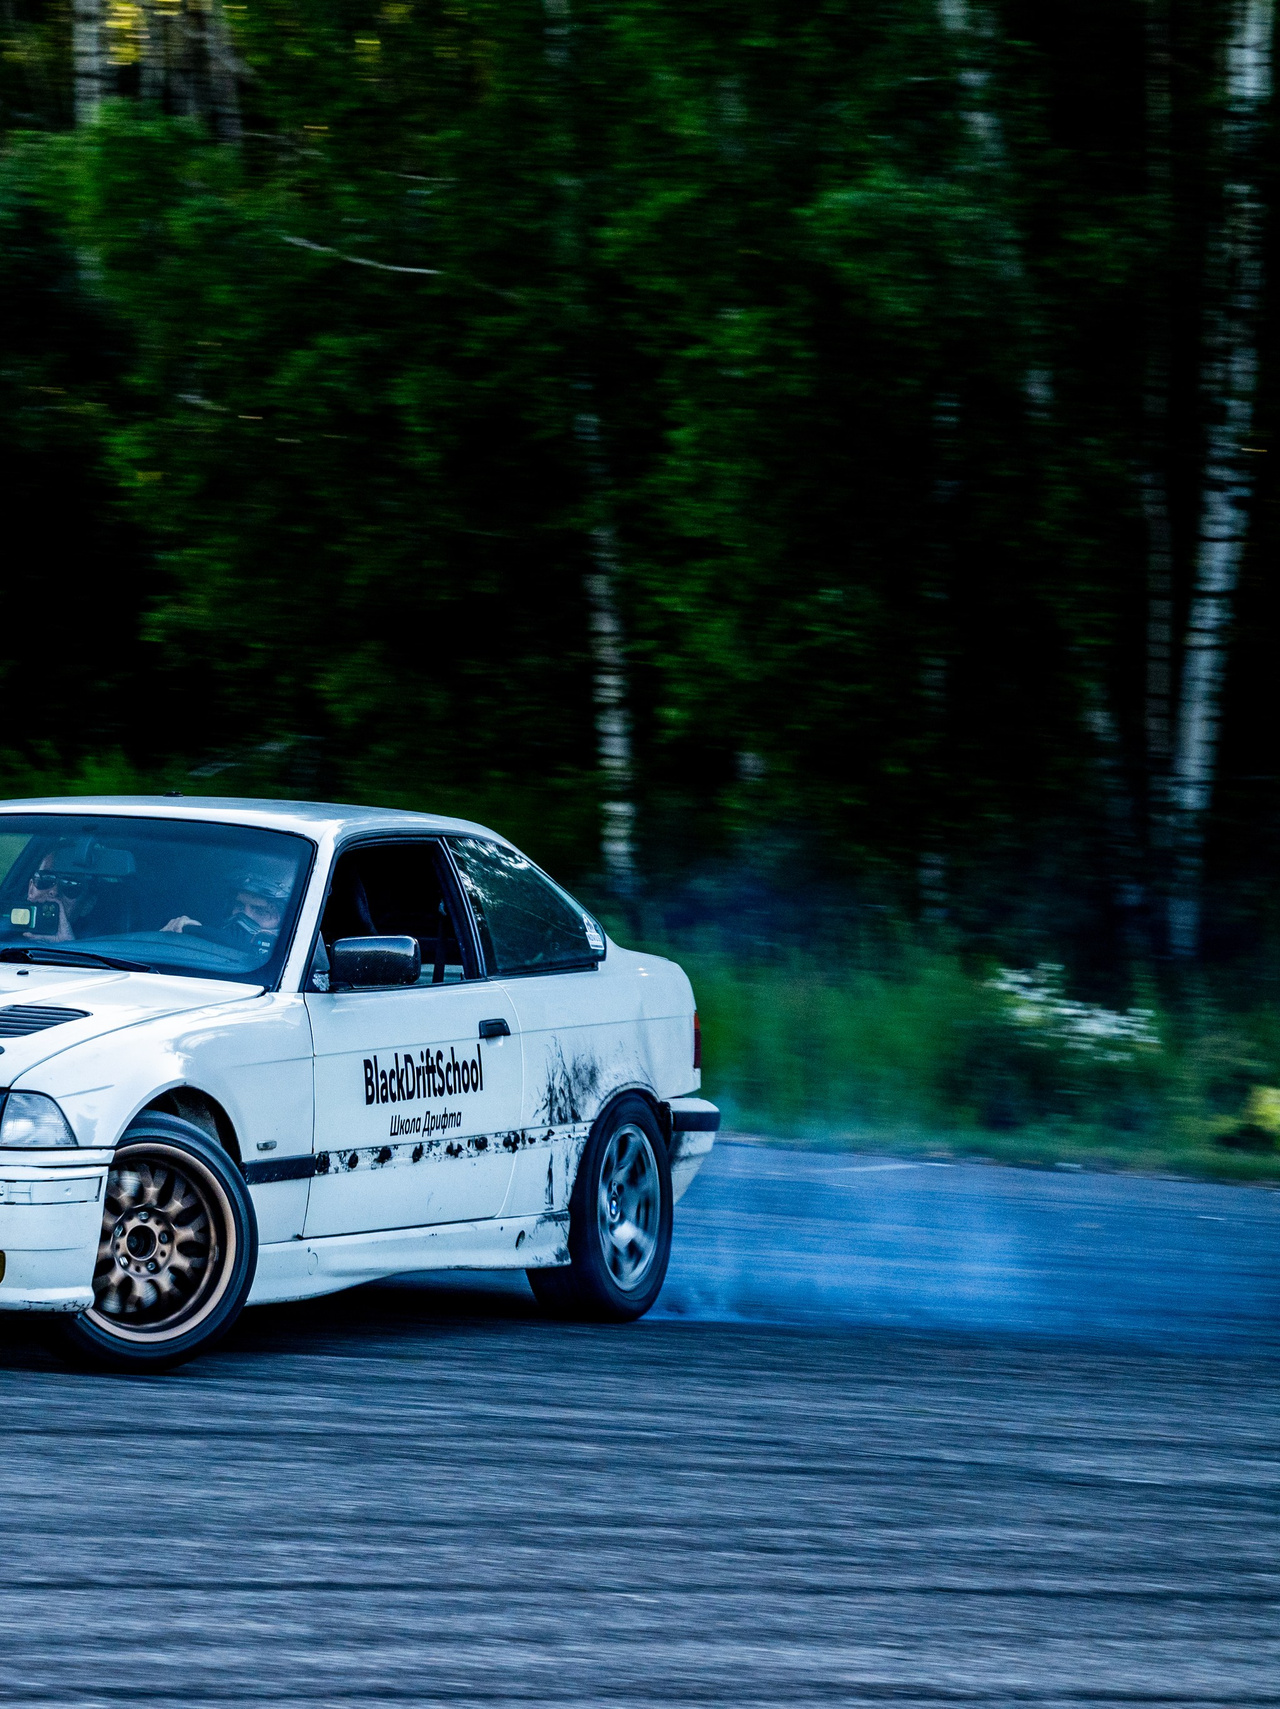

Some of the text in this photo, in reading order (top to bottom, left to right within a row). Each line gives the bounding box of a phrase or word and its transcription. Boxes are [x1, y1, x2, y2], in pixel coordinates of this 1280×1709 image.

[363, 1043, 484, 1106] BlackDriftSchool
[389, 1107, 462, 1138] Школа Дрифта
